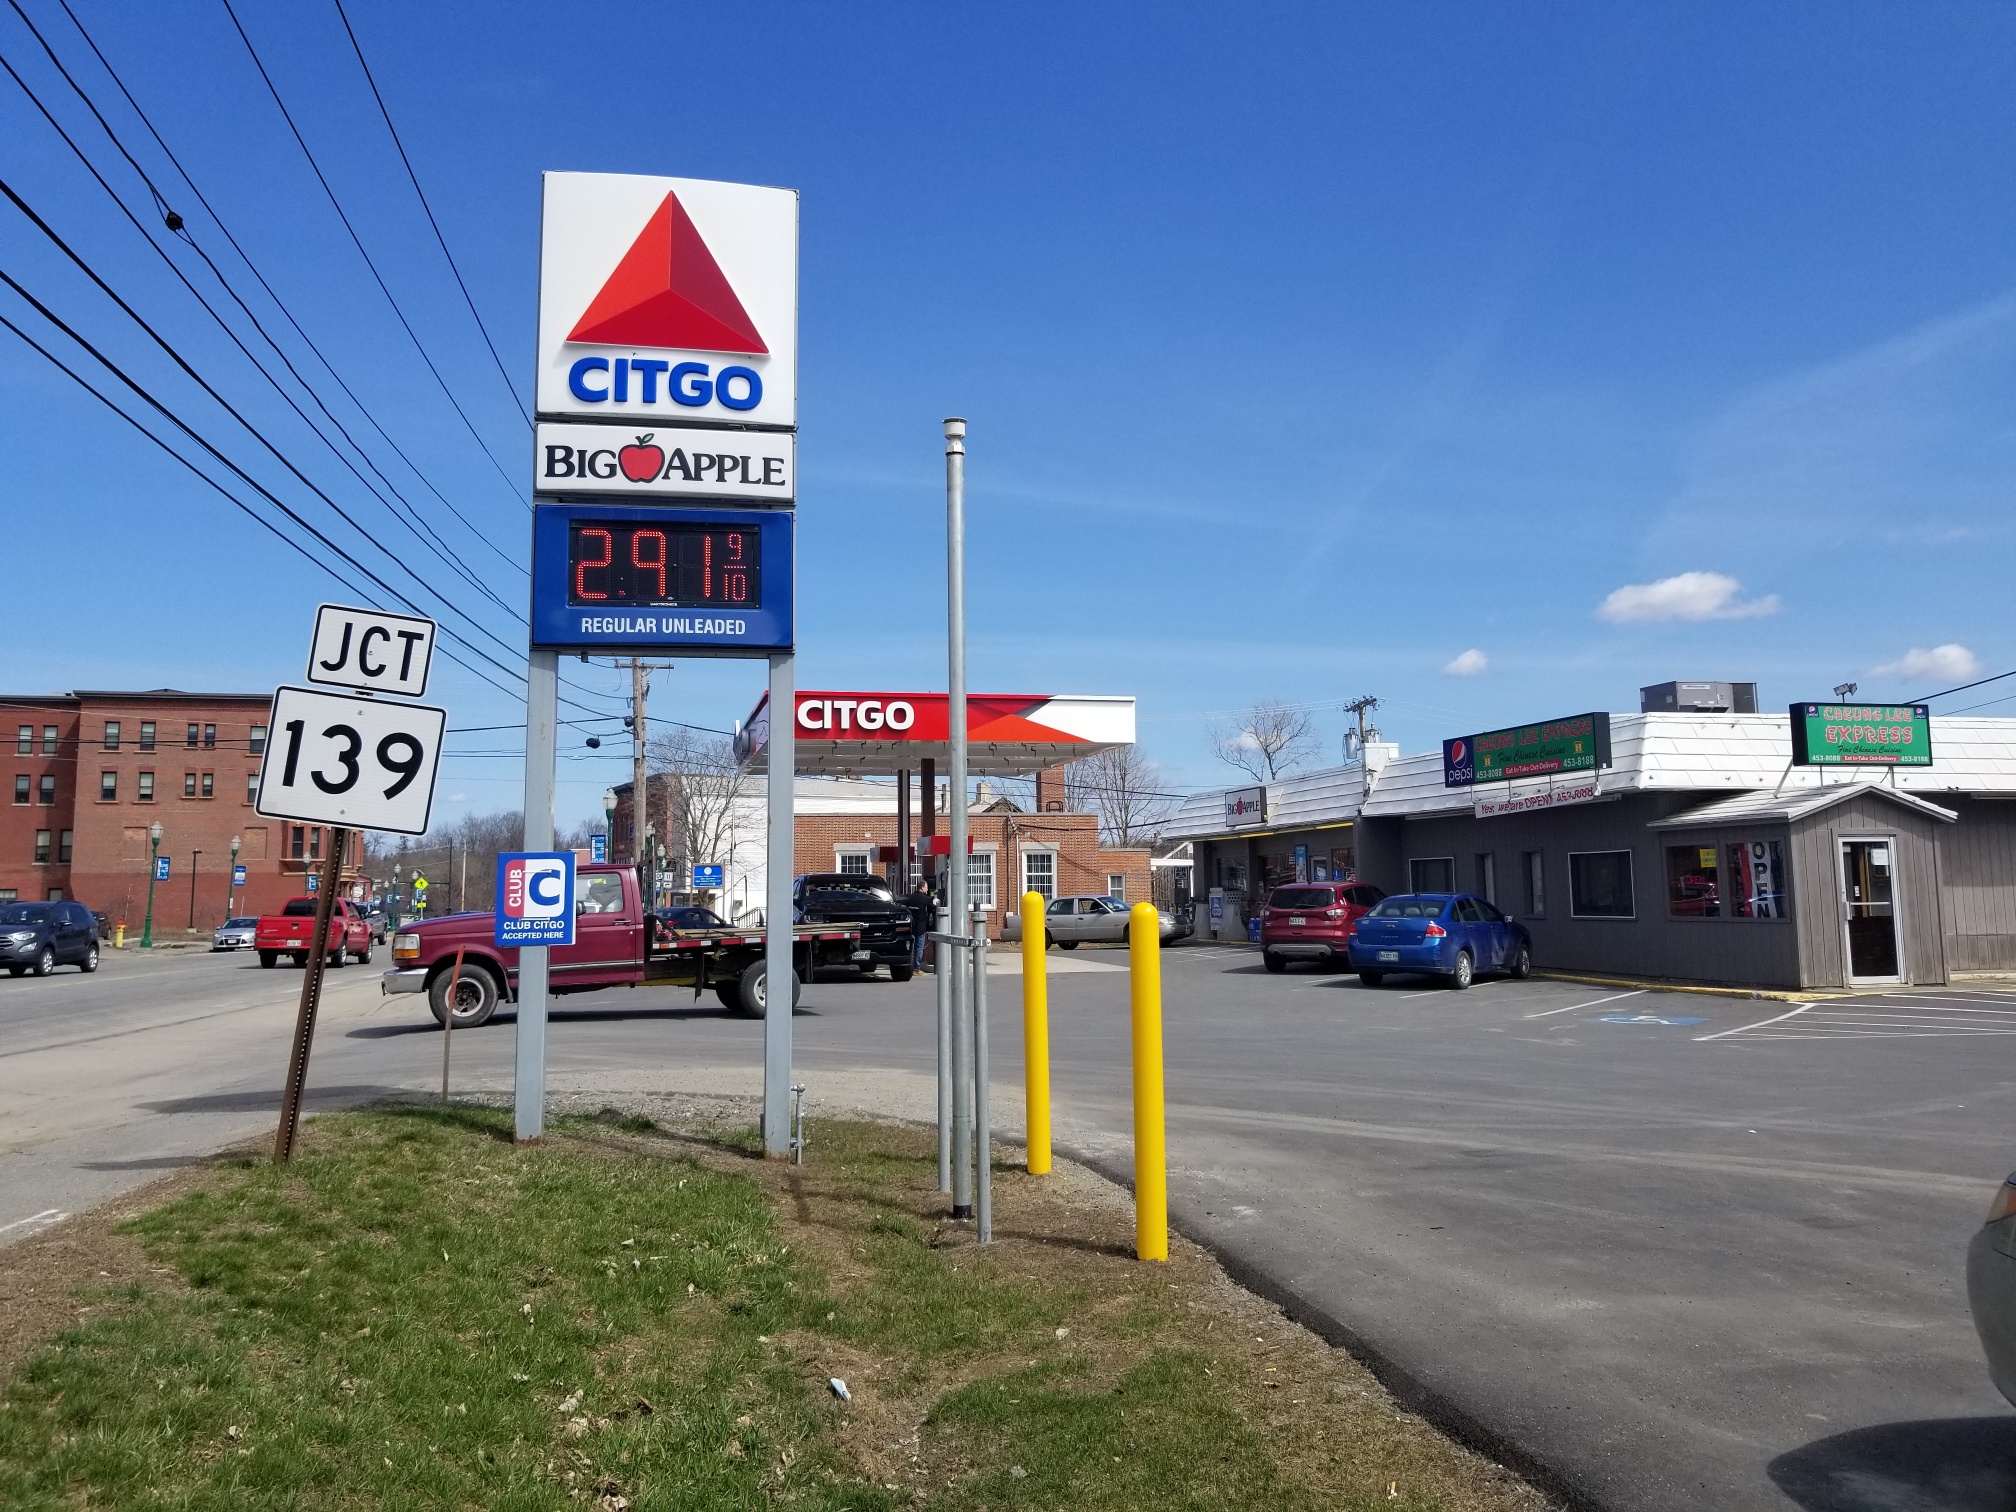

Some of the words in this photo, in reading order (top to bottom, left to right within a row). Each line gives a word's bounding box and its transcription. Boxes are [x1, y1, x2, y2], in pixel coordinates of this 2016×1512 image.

[568, 356, 763, 411] CITGO
[544, 444, 617, 479] BIG
[661, 447, 786, 486] APPLE
[581, 617, 657, 634] REGULAR
[662, 618, 746, 635] UNLEADED
[319, 622, 425, 681] JCT
[797, 700, 915, 730] CITGO
[1823, 707, 1883, 722] CHEUNG
[1885, 708, 1912, 723] LEE
[1474, 730, 1515, 753] CHEUNG
[1518, 727, 1539, 746] LEE
[1541, 717, 1593, 742] EXPRESS
[1825, 724, 1913, 744] EXPRESS
[1497, 752, 1512, 765] Fine
[1513, 749, 1539, 763] Chinese
[1837, 745, 1851, 754] Fine
[1853, 745, 1878, 754] Chinese
[1879, 745, 1902, 754] Cuisine
[282, 718, 425, 801] 139
[1562, 755, 1594, 768] 453-8188
[1448, 765, 1473, 784] pepsi
[1227, 803, 1238, 816] BIG
[1242, 800, 1260, 814] APPLE
[508, 868, 523, 907] CLUB
[1752, 842, 1771, 918] OPEN
[503, 921, 531, 930] CLUB
[533, 920, 565, 930] CITGO
[502, 932, 542, 940] ACCEPTED
[543, 931, 564, 939] HERE
